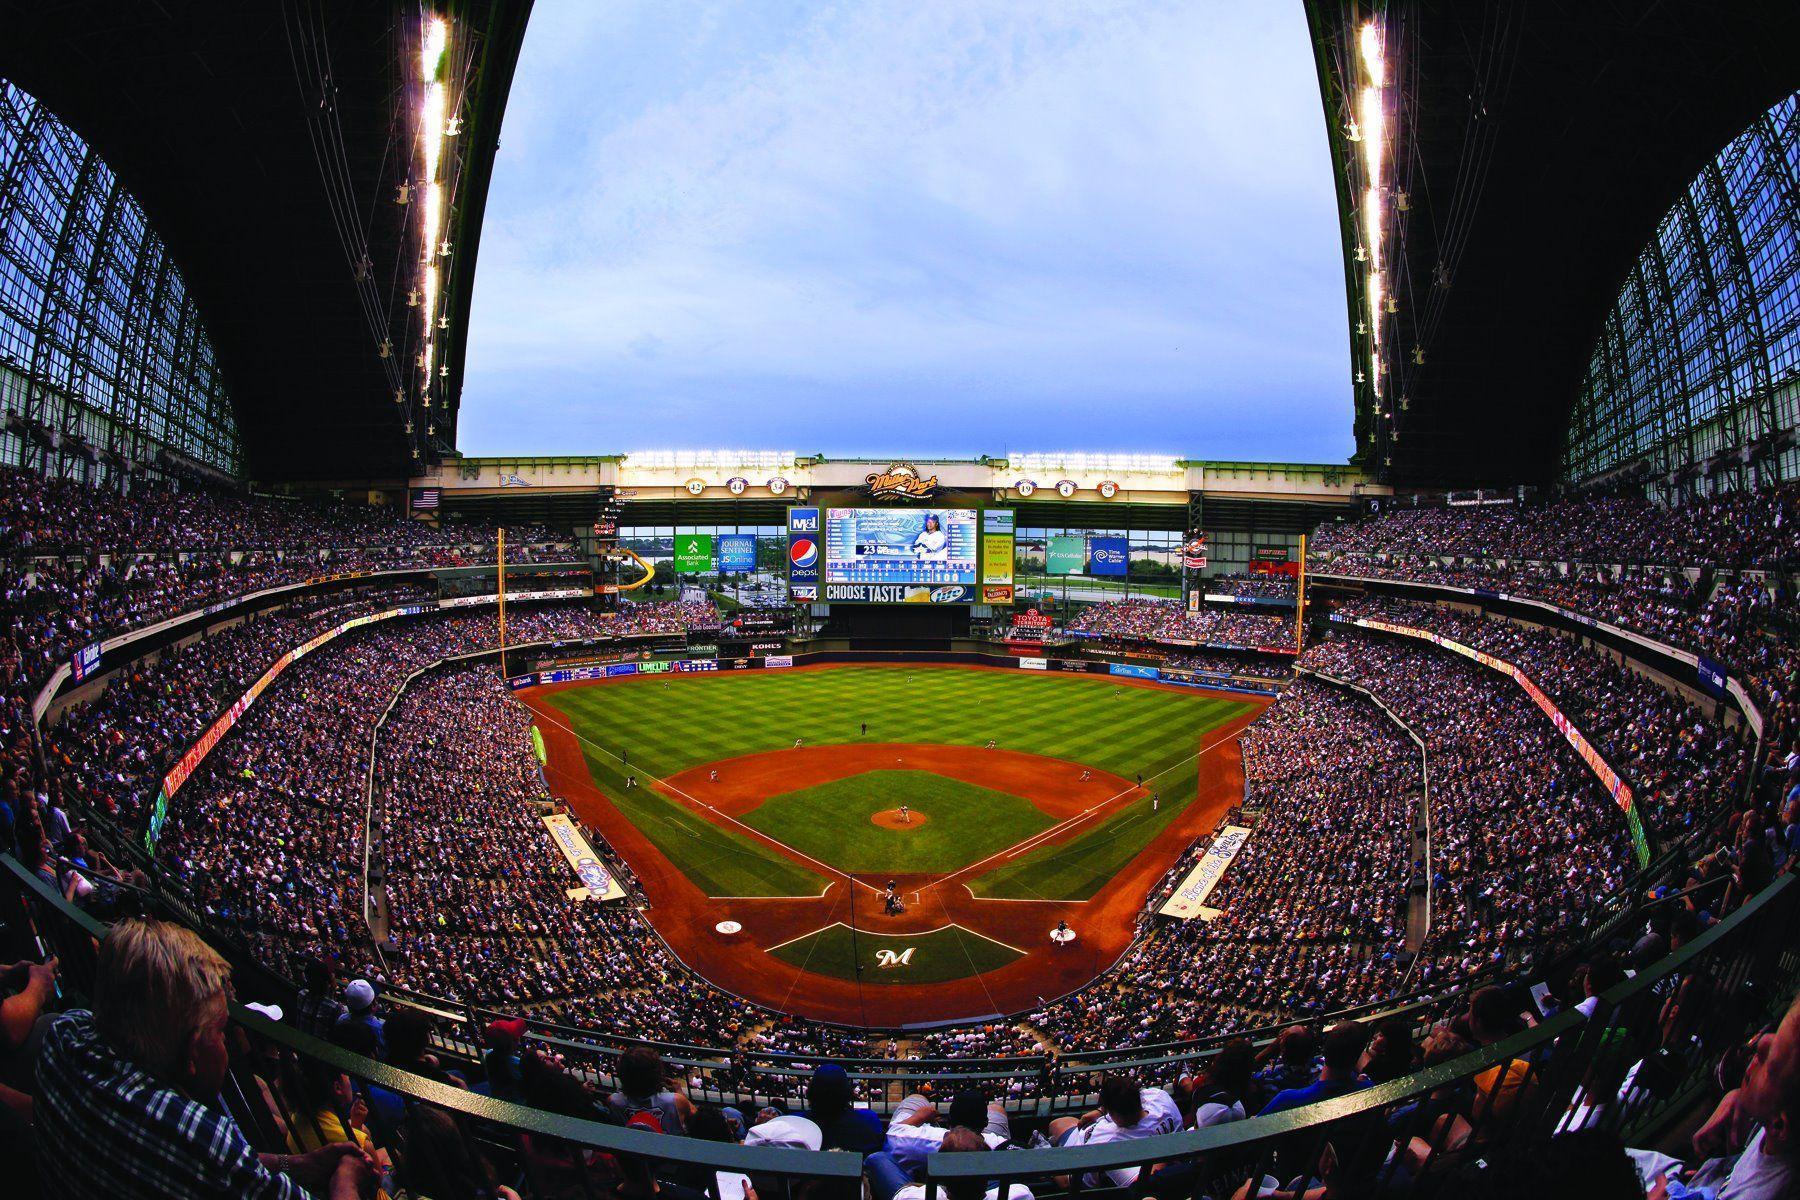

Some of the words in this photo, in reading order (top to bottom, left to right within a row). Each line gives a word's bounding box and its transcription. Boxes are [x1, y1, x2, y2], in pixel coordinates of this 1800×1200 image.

[865, 473, 911, 491] Miller
[903, 475, 938, 494] Park
[863, 545, 876, 555] 23
[792, 569, 818, 577] pepsi
[826, 585, 866, 600] CHOOSE
[1017, 615, 1048, 623] TOYOTA
[639, 662, 670, 671] LIMELITE
[519, 677, 531, 685] bank
[876, 947, 917, 967] M
